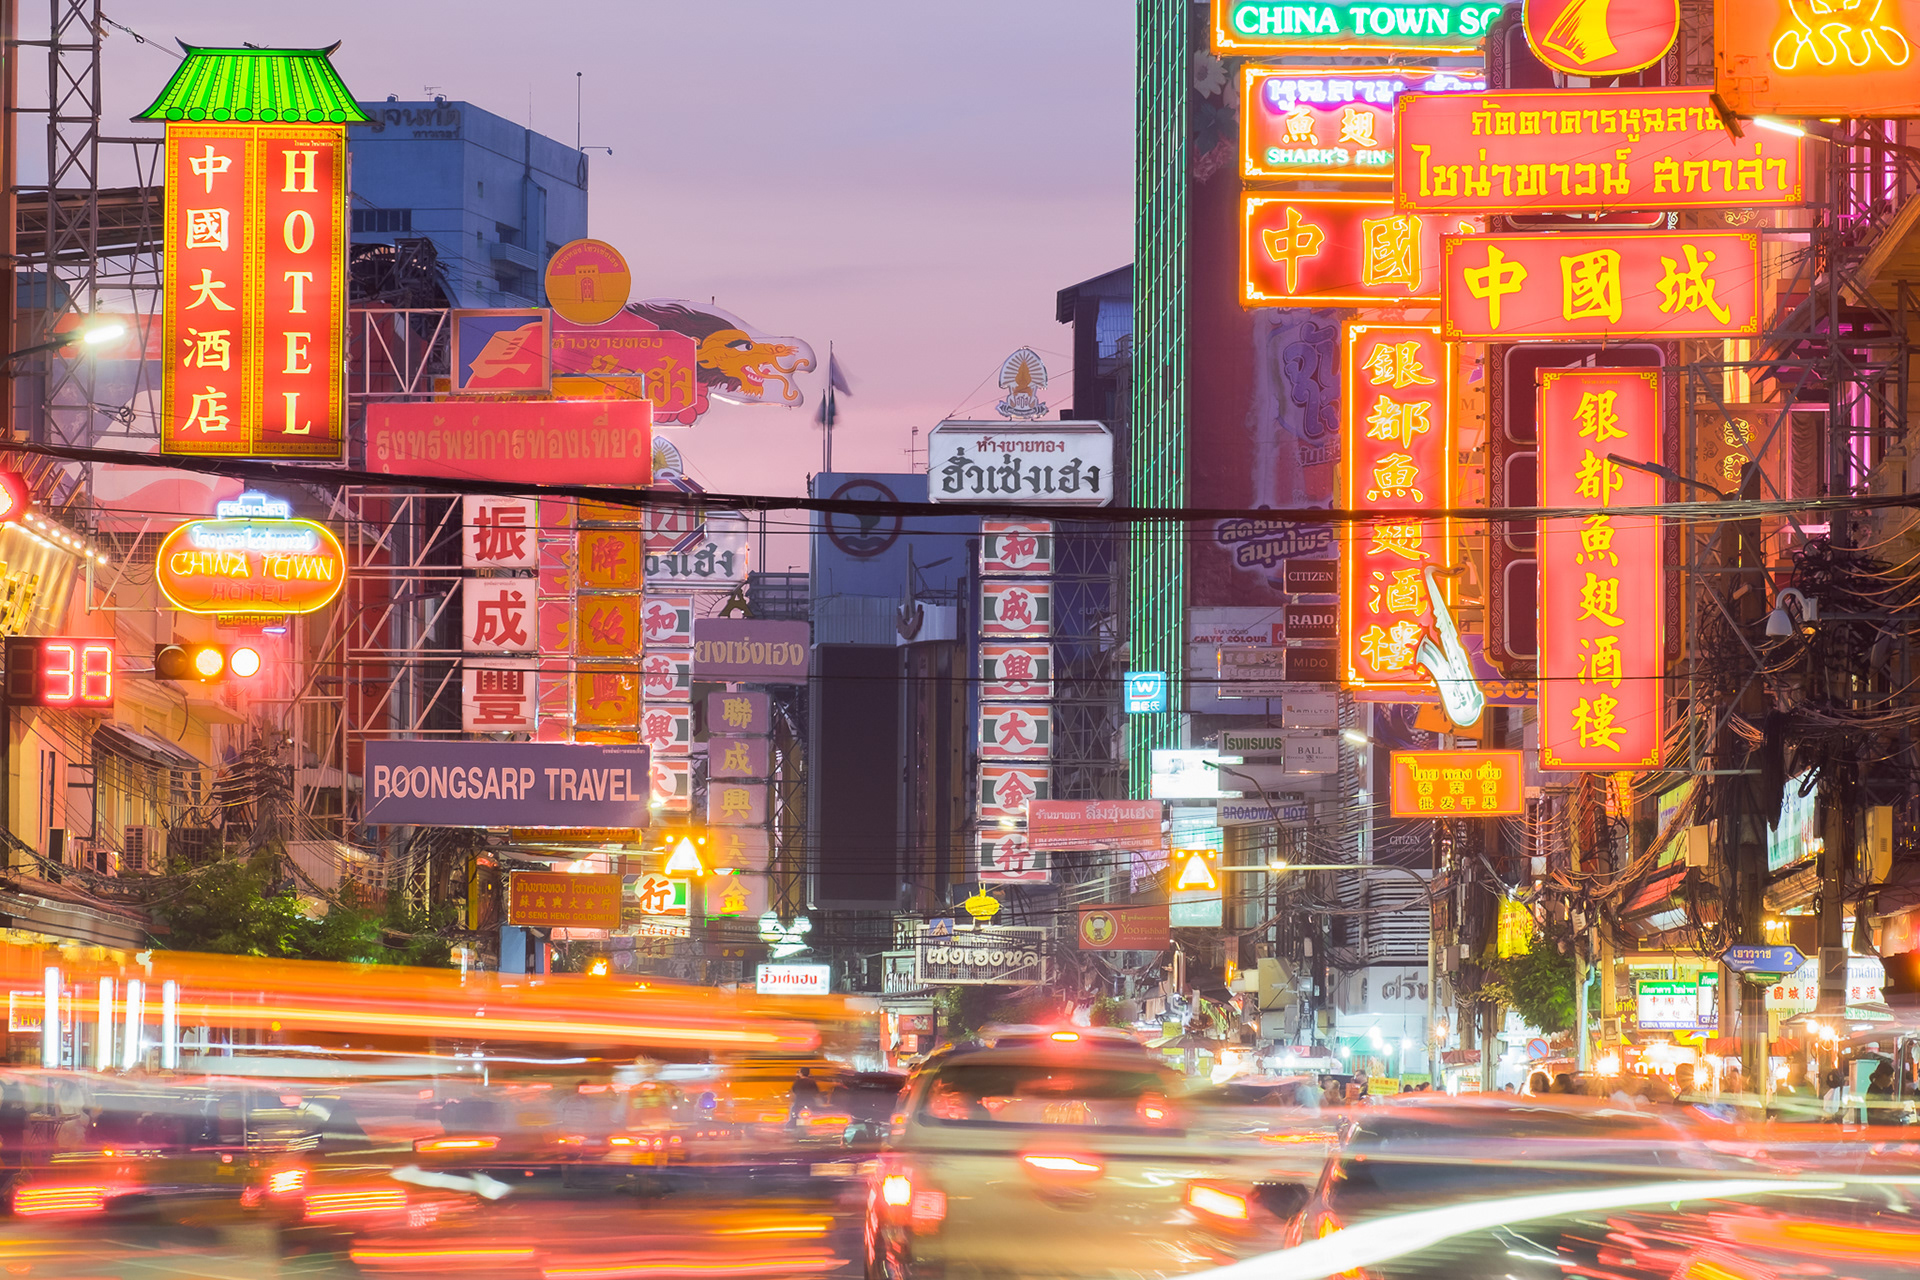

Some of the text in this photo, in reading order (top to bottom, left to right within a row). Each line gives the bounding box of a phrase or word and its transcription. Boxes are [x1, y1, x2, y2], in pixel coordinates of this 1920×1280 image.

[1236, 5, 1339, 34] CHINA
[1349, 7, 1449, 34] TOWN
[1282, 108, 1377, 146] 魚翅
[1268, 147, 1349, 164] SHARK'S
[1411, 142, 1788, 198] ไชน่าทาวน์ สกาล่า
[1262, 206, 1476, 294] 中國
[181, 144, 234, 434] 中國大酒店
[281, 150, 319, 435] HOTEL
[1463, 245, 1732, 330] 中國城
[552, 334, 663, 349] ห้างขายทอง
[376, 404, 641, 473] รุ่งทรัพย์การท่องเที่ยว
[976, 436, 1065, 453] ห้างขายทอง
[941, 447, 1101, 493] ฮั่วเซ่งเฮง
[1361, 341, 1436, 676] 銀都魚翅酒樓
[1240, 529, 1331, 564] สมุนไพร
[171, 551, 333, 580] CHINA TOWN
[1288, 572, 1334, 581] CITIZEN
[1571, 390, 1628, 753] 銀都魚翅酒樓
[212, 583, 291, 602] HOTEL
[473, 506, 527, 725] 振成豐
[1288, 615, 1334, 625] RADO
[1294, 658, 1328, 668] MIDO
[1136, 680, 1154, 693] W
[994, 529, 1037, 875] 和成興大金行
[374, 765, 640, 802] ROONGSARP TRAVEL
[719, 697, 754, 914] 聯成興大金
[1035, 802, 1154, 823] ร้านขายยา ลิ้มชุ่นเฮง
[1223, 806, 1280, 820] BROADWAY
[1390, 836, 1420, 845] CITIZEN
[517, 879, 566, 893] ห้างขายทอง
[515, 911, 615, 921] SO SENG HENG GOLDSMITH
[1733, 950, 1793, 965] เยาวราช 2
[1765, 986, 1816, 999] 國城銀
